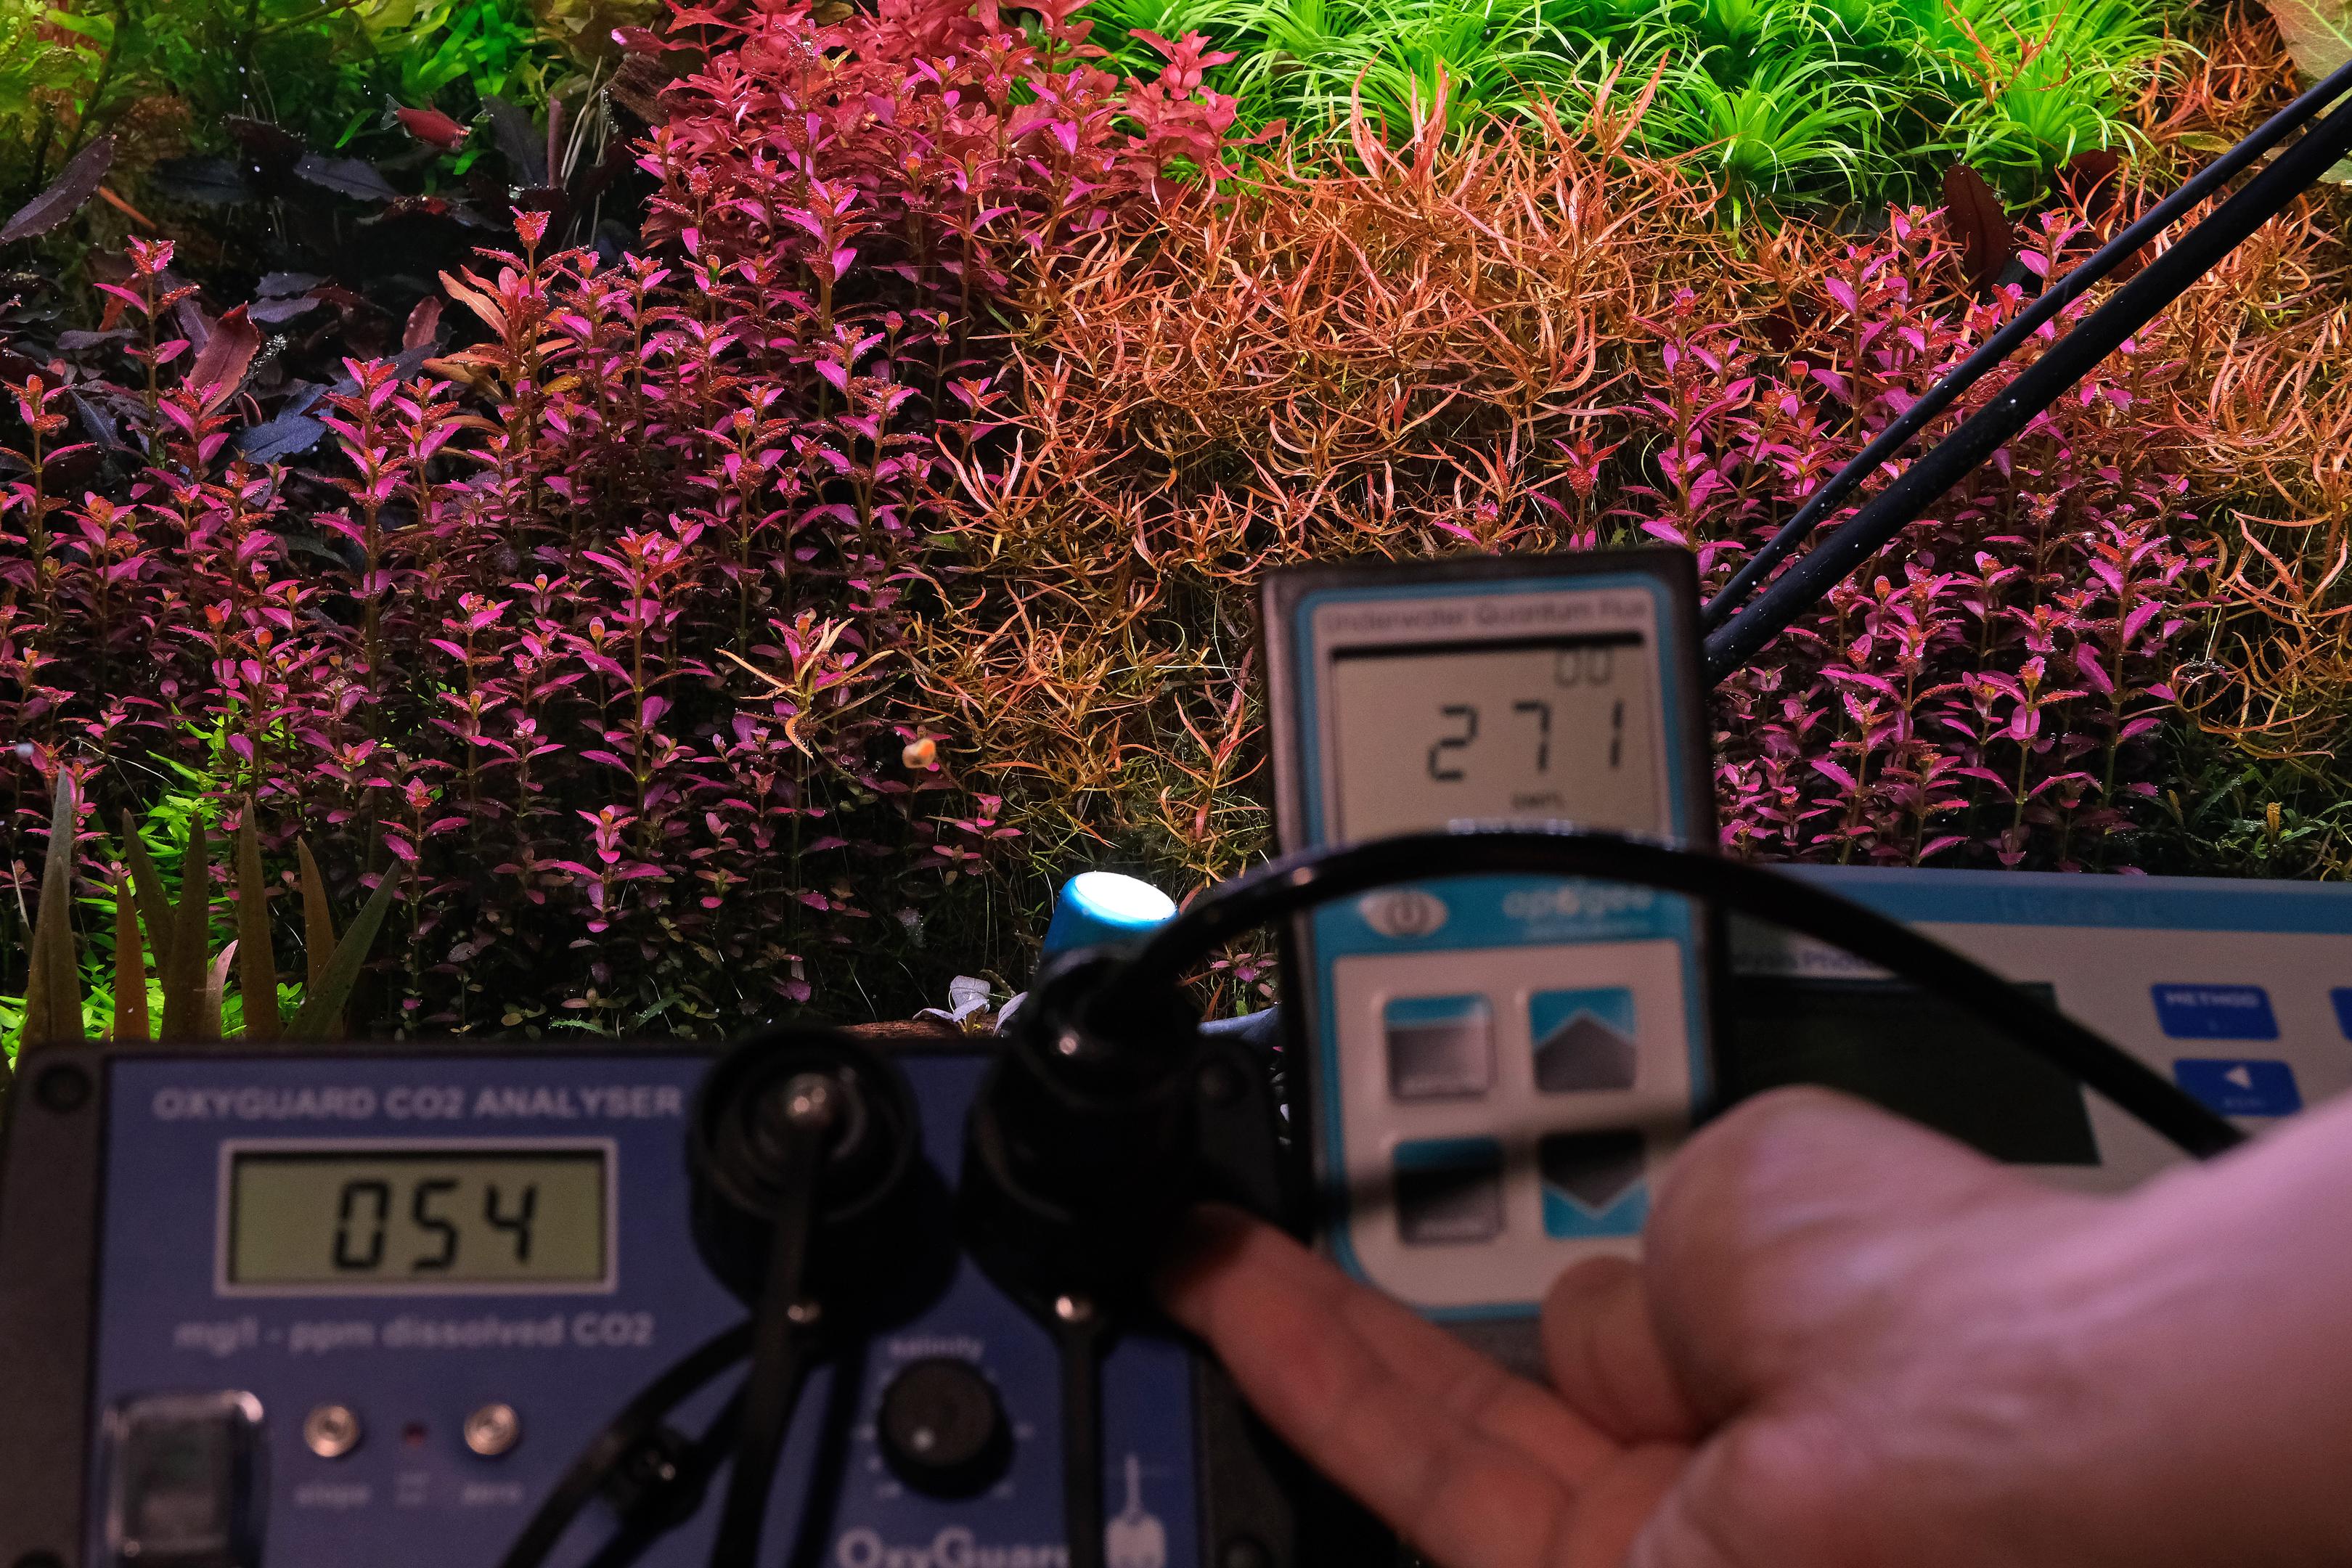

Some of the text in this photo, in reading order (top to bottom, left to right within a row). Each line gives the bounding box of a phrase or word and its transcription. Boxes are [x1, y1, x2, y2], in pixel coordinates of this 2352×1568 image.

[1427, 699, 1625, 782] 271
[2165, 990, 2260, 1009] METHOD
[152, 1086, 683, 1120] OXYGUARD CO2 ANALYSER
[332, 1179, 538, 1271] 054
[289, 1321, 375, 1354] ppm
[383, 1313, 565, 1348] dissolved
[571, 1312, 655, 1347] CO2
[836, 1526, 1070, 1568] OxyGuar
